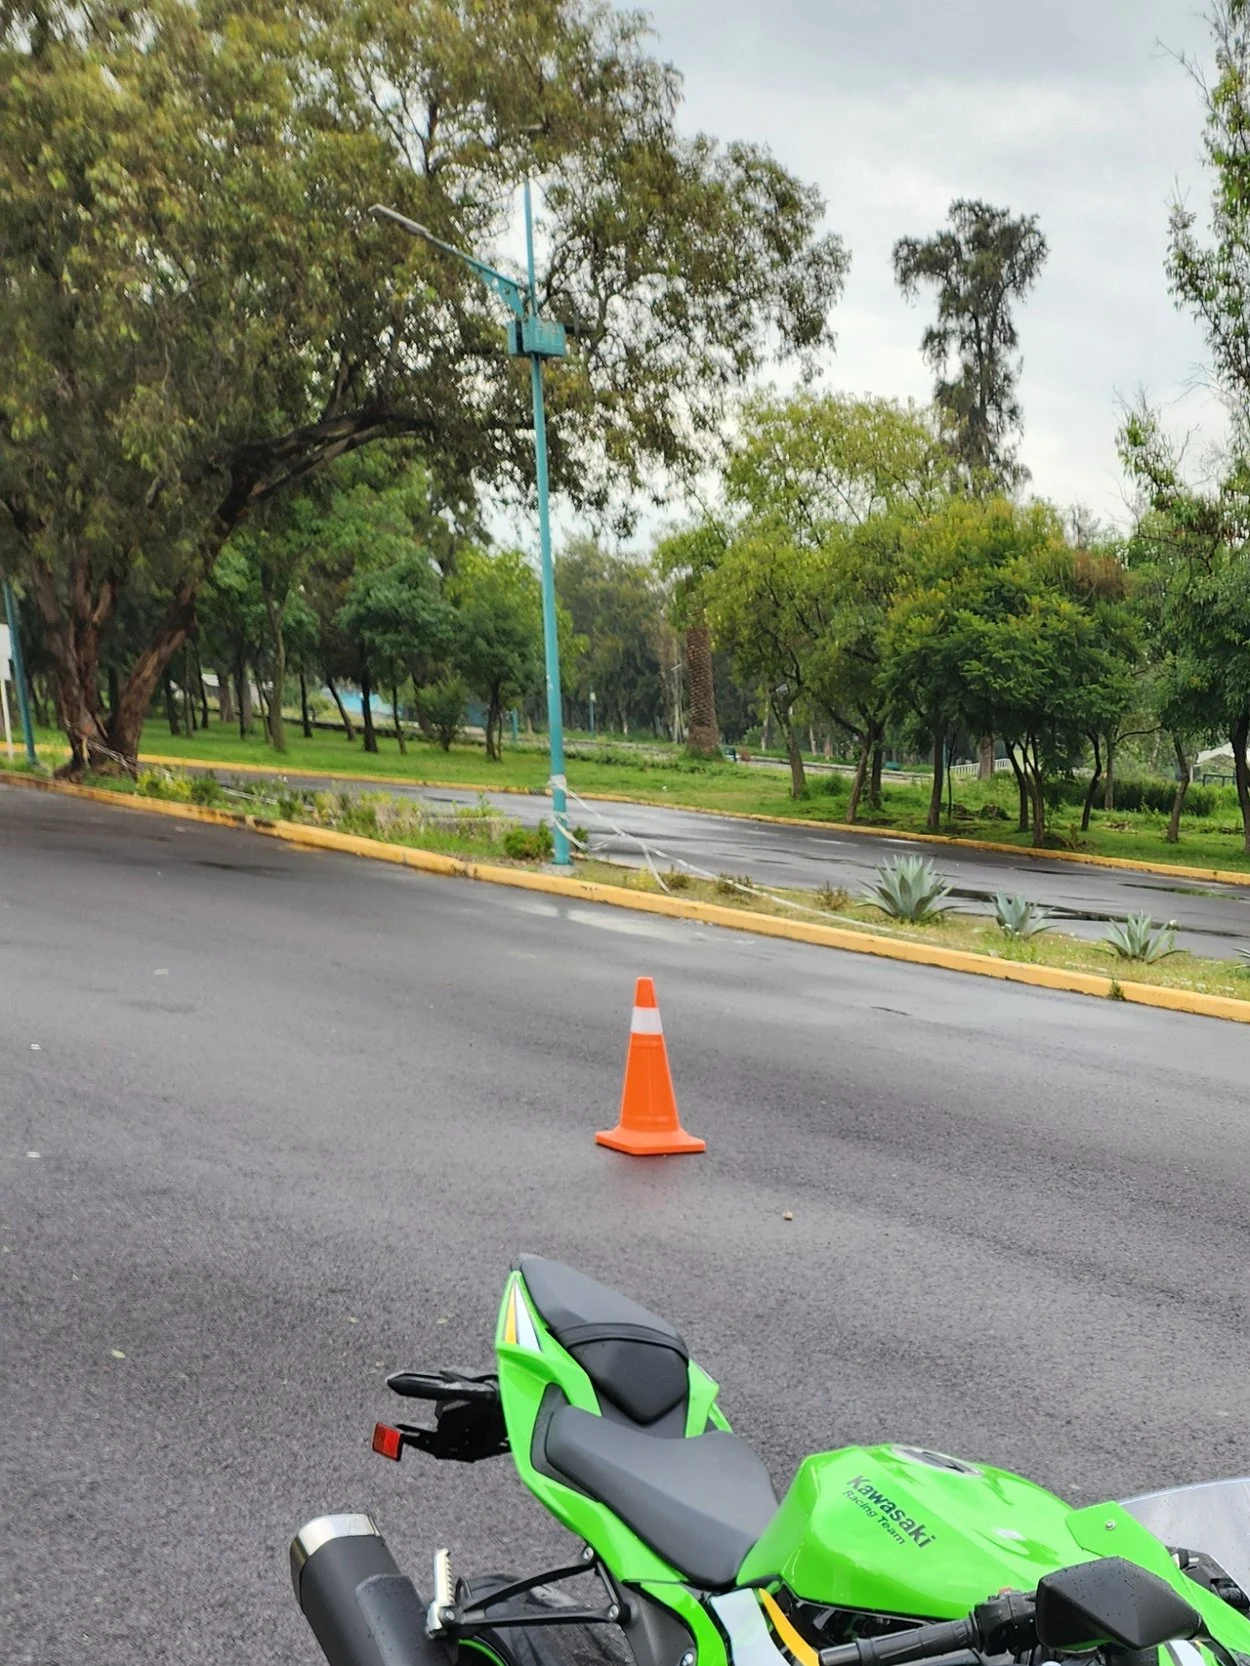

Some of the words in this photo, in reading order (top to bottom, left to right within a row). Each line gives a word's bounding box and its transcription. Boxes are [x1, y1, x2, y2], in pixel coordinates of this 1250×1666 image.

[842, 1490, 878, 1517] Racing
[877, 1515, 906, 1545] Team
[846, 1475, 937, 1548] Kawasaki
